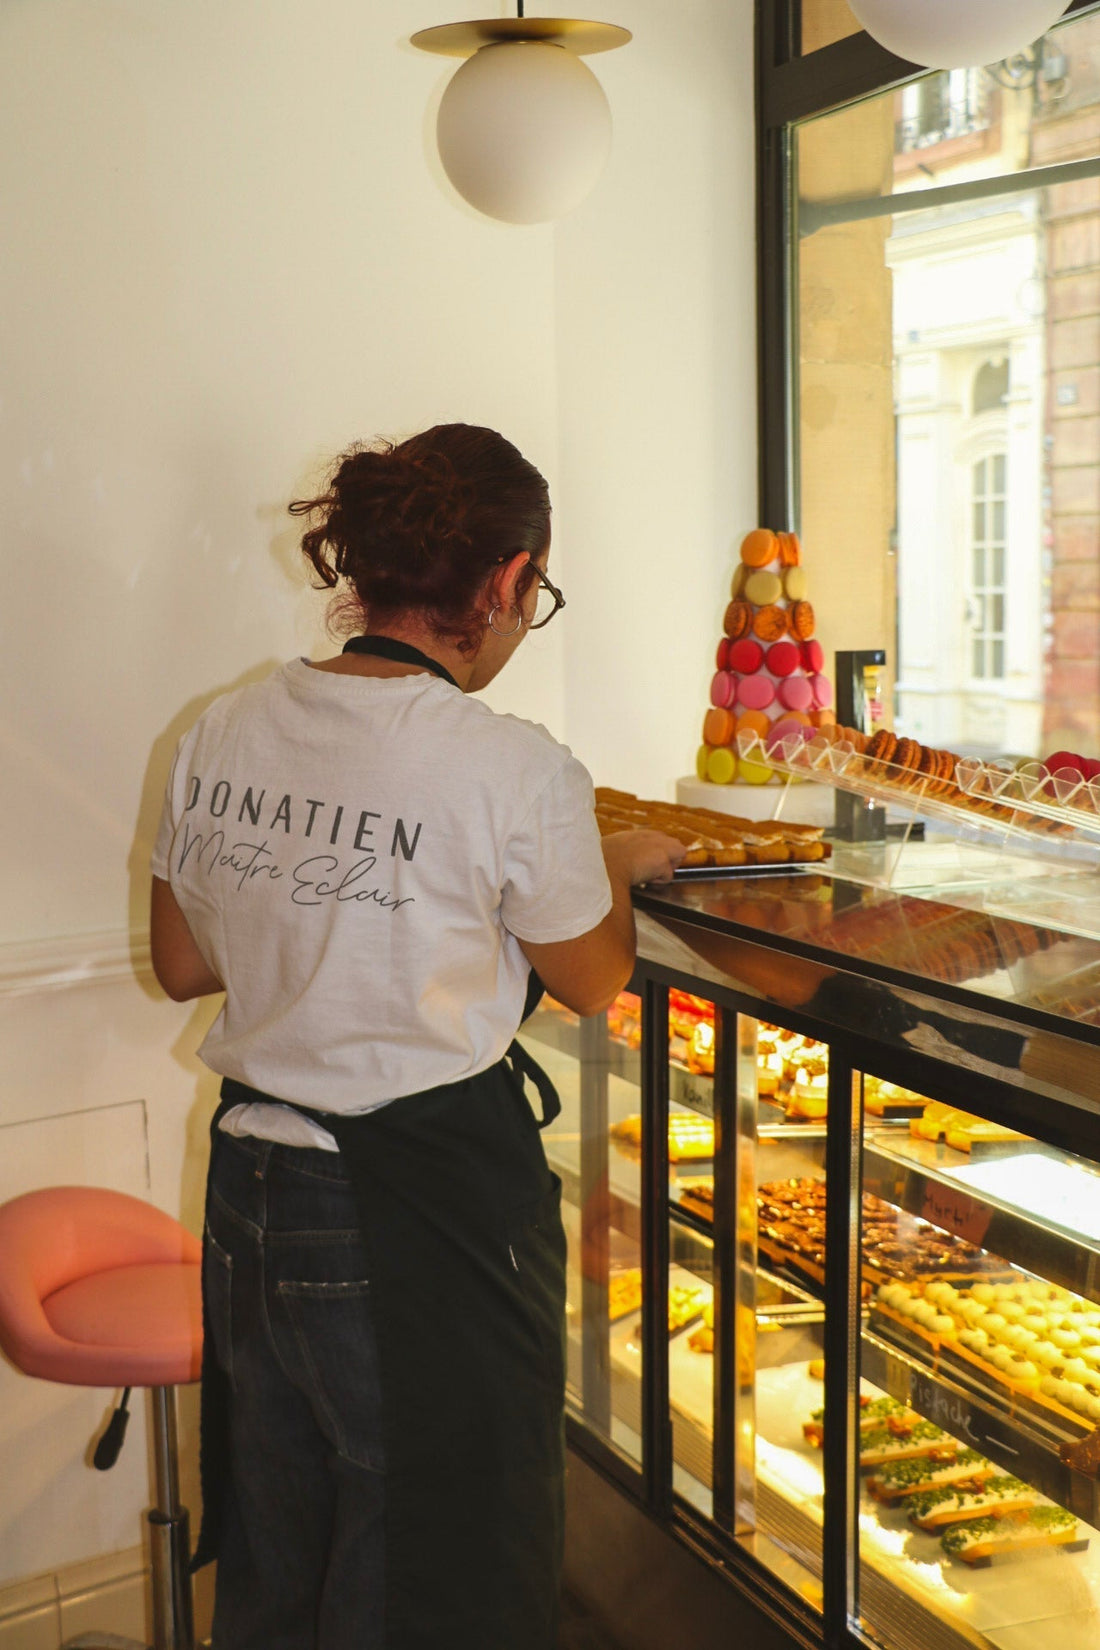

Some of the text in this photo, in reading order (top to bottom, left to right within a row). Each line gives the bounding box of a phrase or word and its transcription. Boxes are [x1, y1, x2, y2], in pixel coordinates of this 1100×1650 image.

[185, 776, 423, 862] DONATIEN
[291, 856, 416, 912] Eclair
[910, 1373, 980, 1442] Pistache
